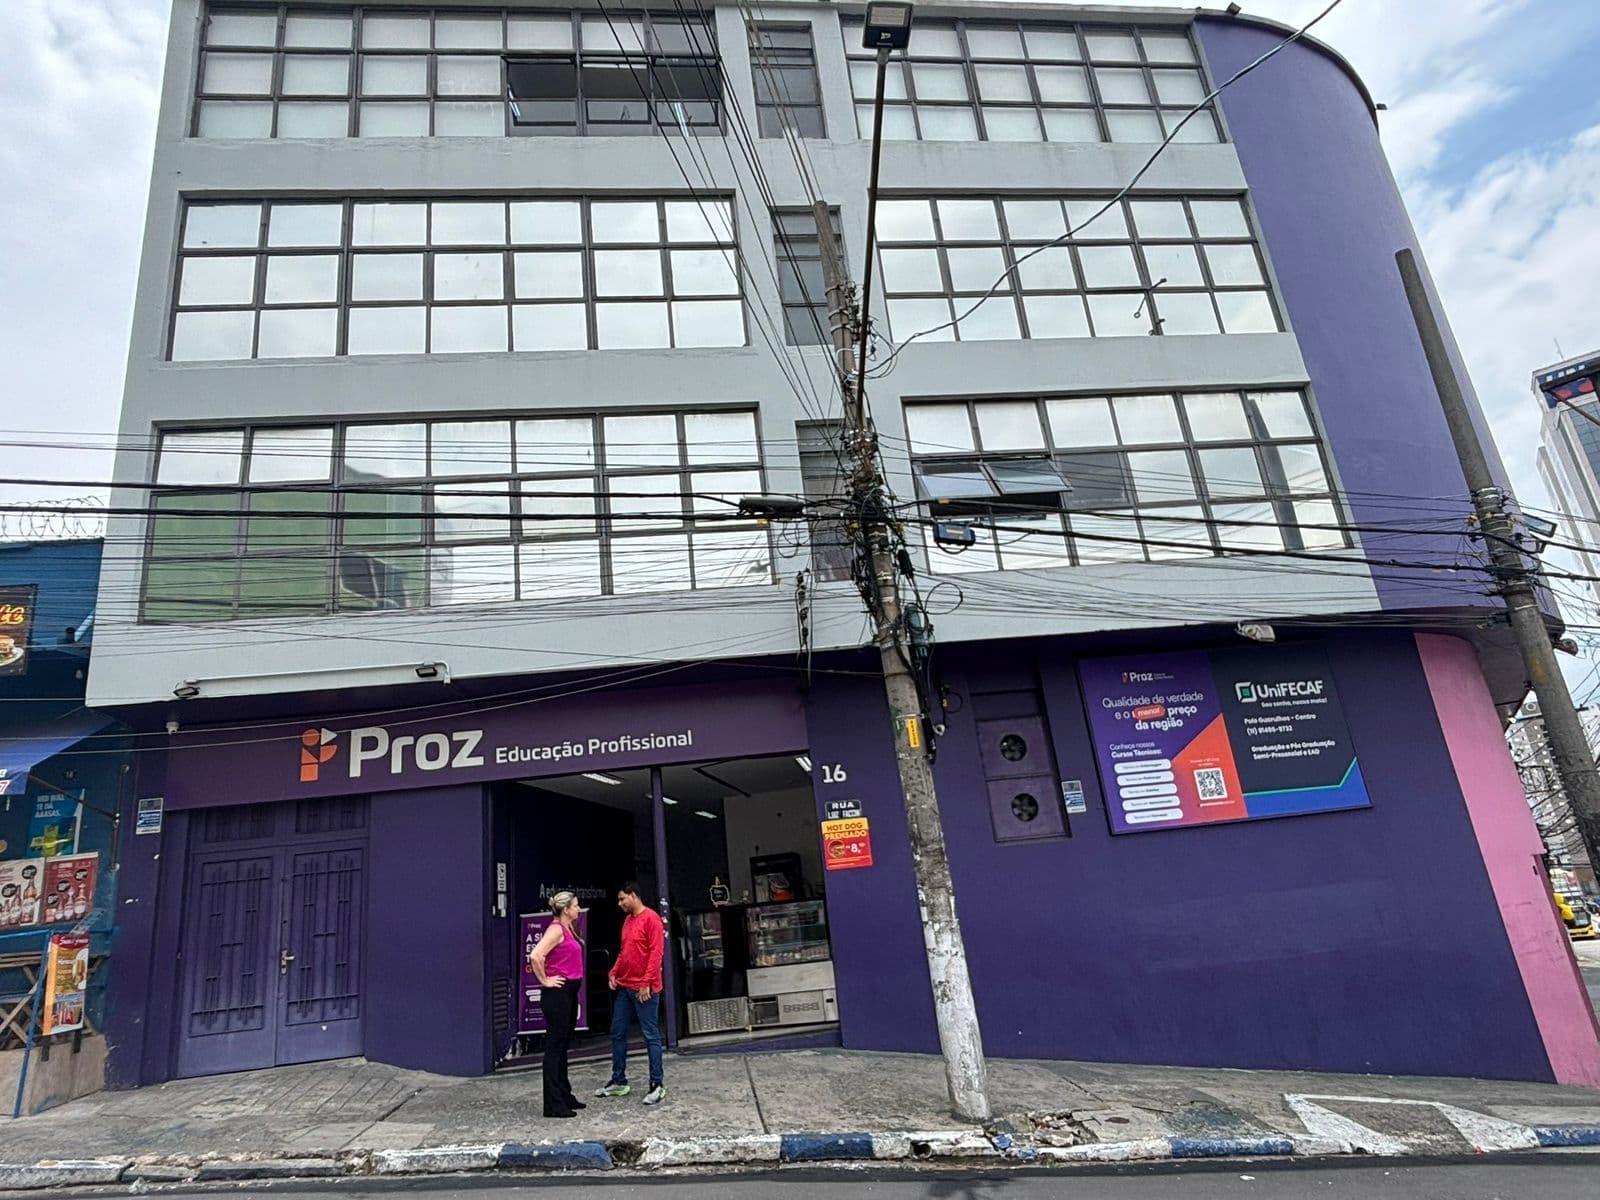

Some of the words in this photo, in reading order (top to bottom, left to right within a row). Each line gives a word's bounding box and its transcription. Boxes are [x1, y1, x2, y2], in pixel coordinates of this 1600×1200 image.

[1129, 672, 1153, 682] Proz
[1257, 680, 1323, 698] UniFECAF
[1102, 695, 1150, 708] Qualidade
[1152, 693, 1164, 704] de
[1166, 691, 1203, 703] verdade
[1115, 711, 1122, 720] e
[1123, 711, 1130, 719] o
[1167, 705, 1197, 717] preço
[1135, 720, 1149, 731] da
[1150, 718, 1183, 731] região
[1258, 715, 1290, 723] Guarulhos
[1109, 742, 1135, 751] Conheça
[349, 727, 484, 778] Proz
[496, 742, 583, 764] Educação
[588, 730, 692, 755] Profissional
[822, 764, 847, 783] 16
[831, 801, 855, 809] RUA
[827, 824, 843, 832] HOT
[845, 822, 863, 830] DOG
[526, 934, 533, 942] A
